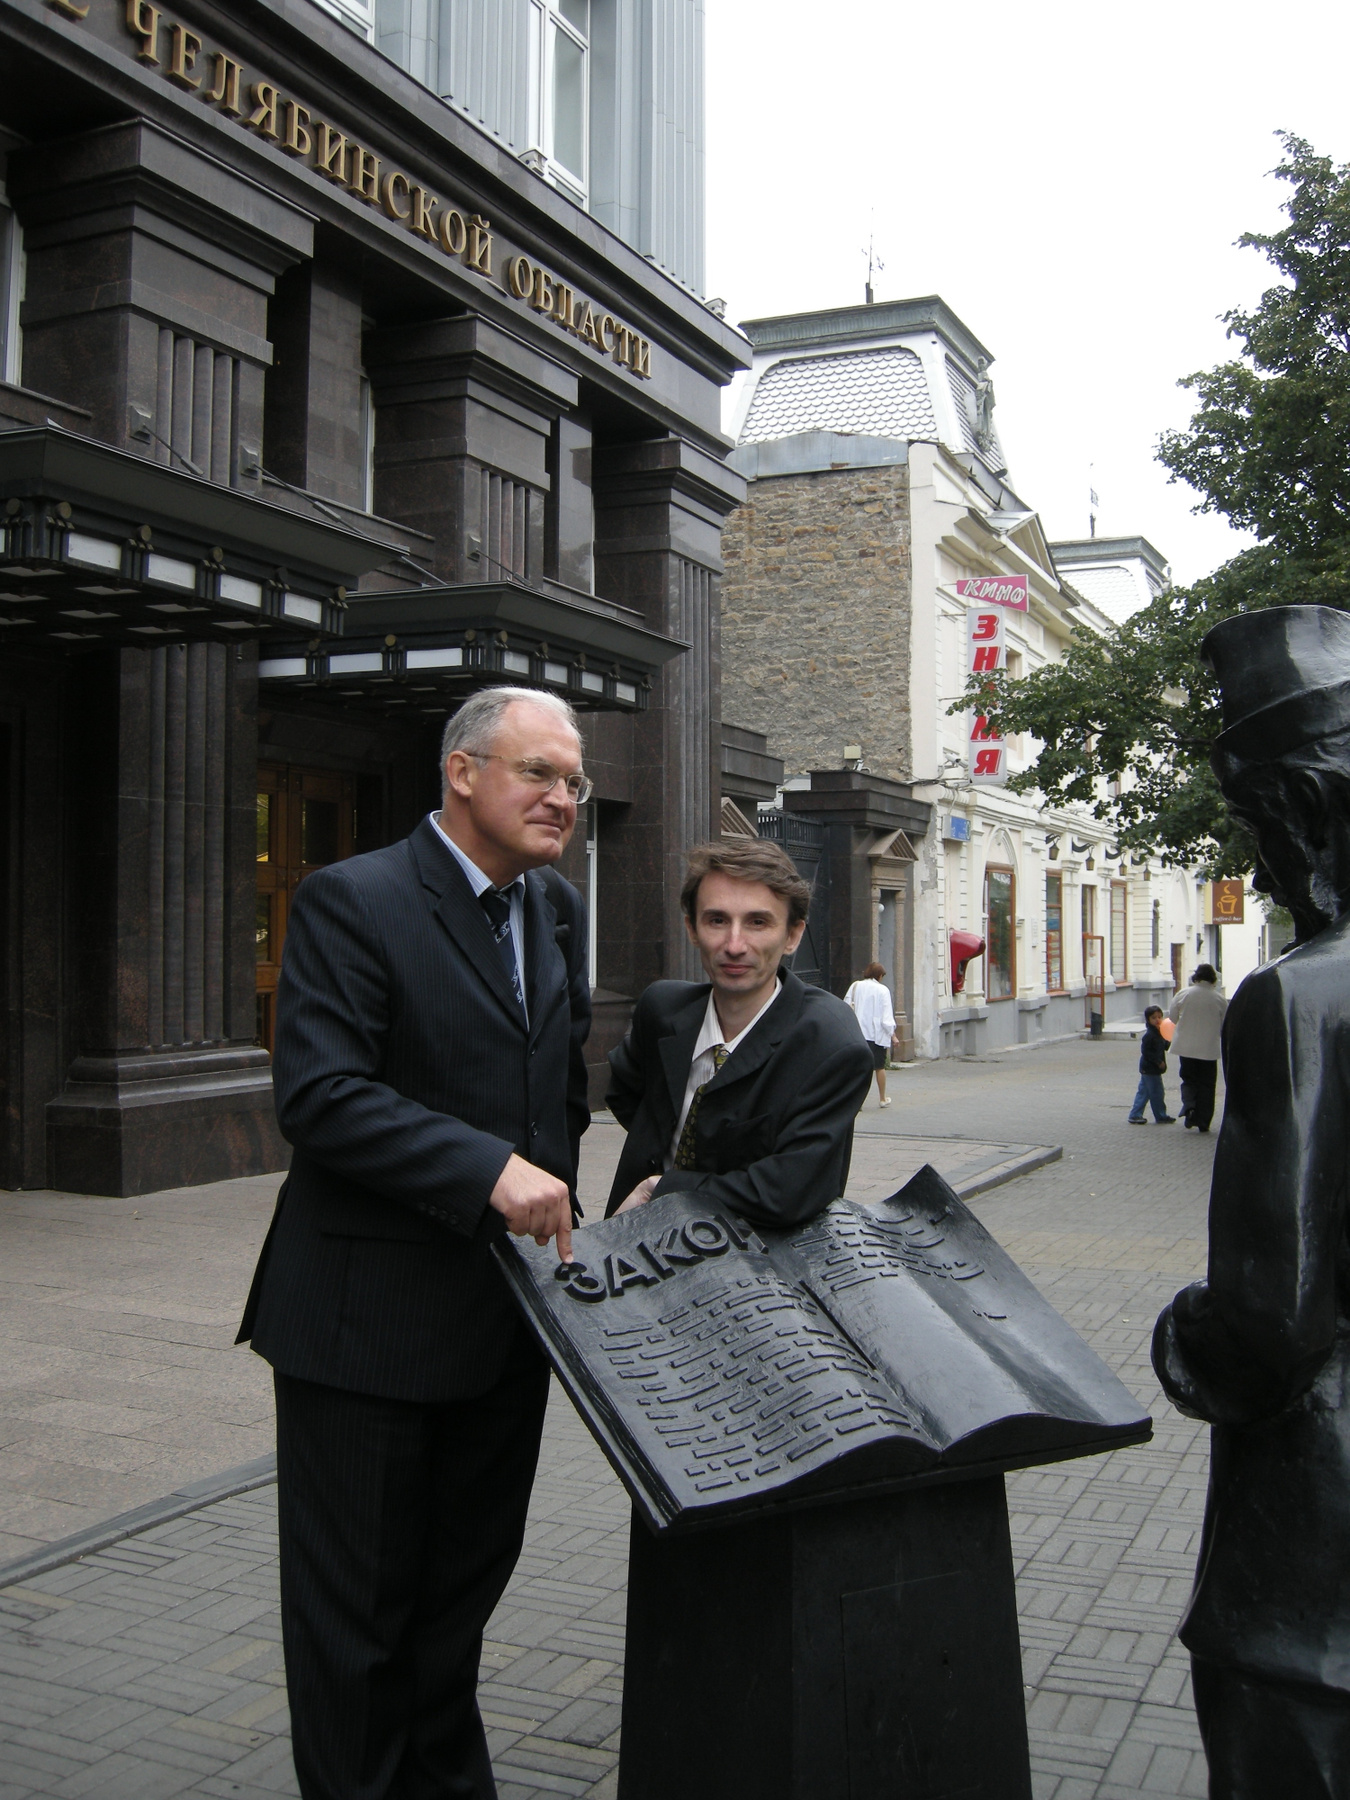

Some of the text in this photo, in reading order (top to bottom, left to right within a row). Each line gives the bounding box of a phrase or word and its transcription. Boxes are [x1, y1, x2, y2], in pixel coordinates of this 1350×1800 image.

[126, 0, 653, 381] ЧЕЛЯБИНСКОЙ ОБЛАСТИ
[963, 579, 1026, 604] КИНО
[969, 614, 1003, 776] ЗНМЯ
